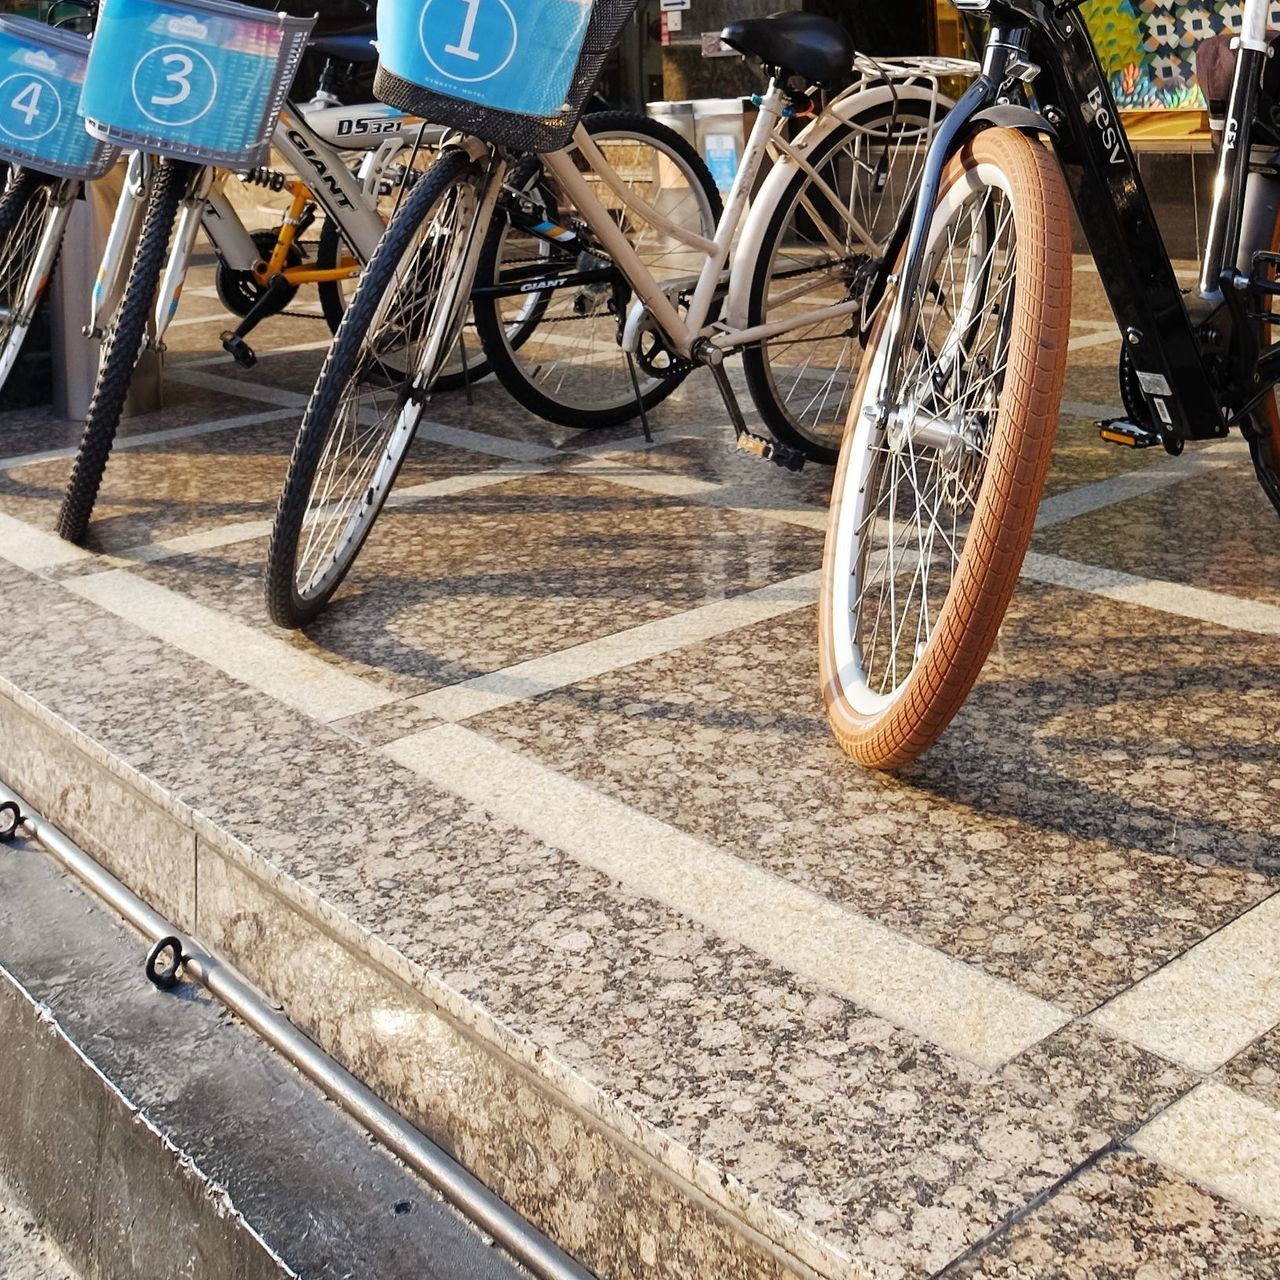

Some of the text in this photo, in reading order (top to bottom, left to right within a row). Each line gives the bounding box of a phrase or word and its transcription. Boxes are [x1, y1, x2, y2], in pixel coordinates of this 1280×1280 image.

[11, 82, 43, 125] 4
[151, 53, 194, 106] 3
[286, 129, 357, 212] GIANT
[520, 278, 568, 292] GIANT
